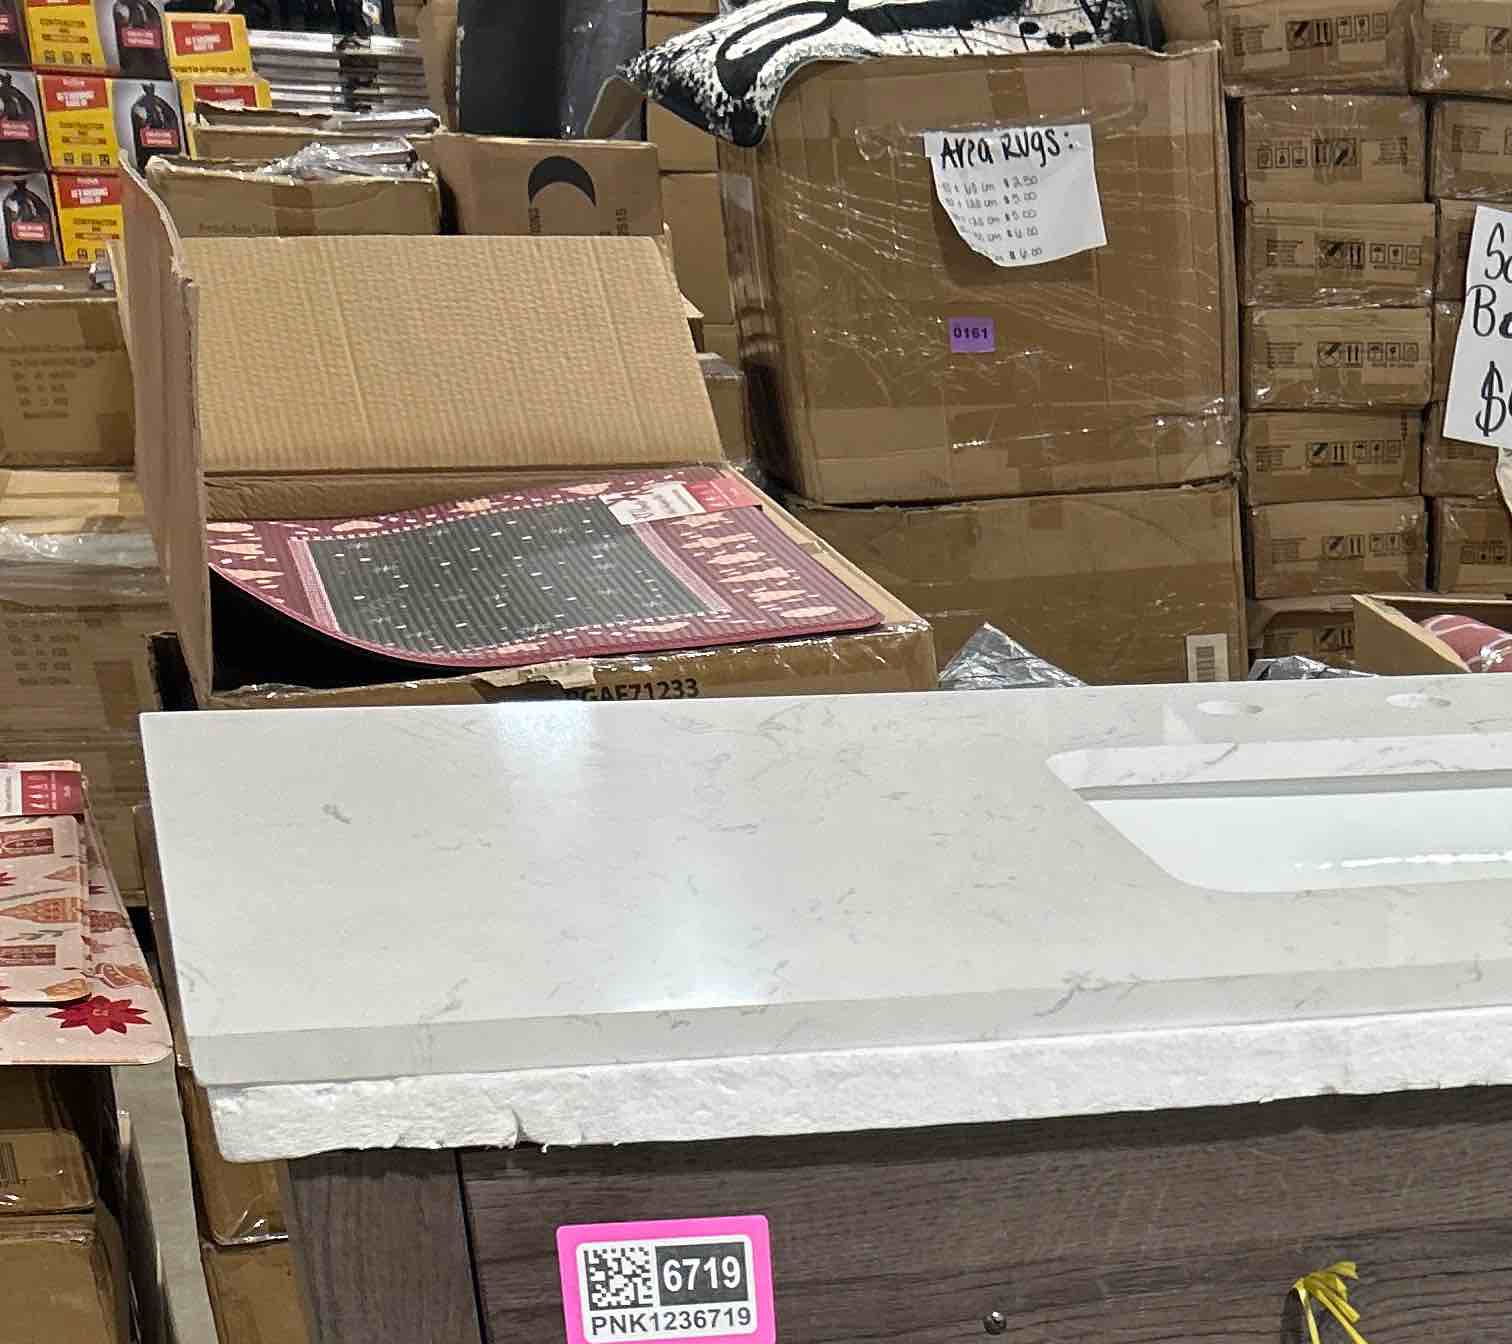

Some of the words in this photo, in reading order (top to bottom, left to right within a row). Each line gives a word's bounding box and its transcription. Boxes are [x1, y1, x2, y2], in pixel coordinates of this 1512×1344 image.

[940, 137, 994, 170] Area
[662, 1255, 741, 1293] 6719
[591, 1306, 752, 1336] PNK1236719
